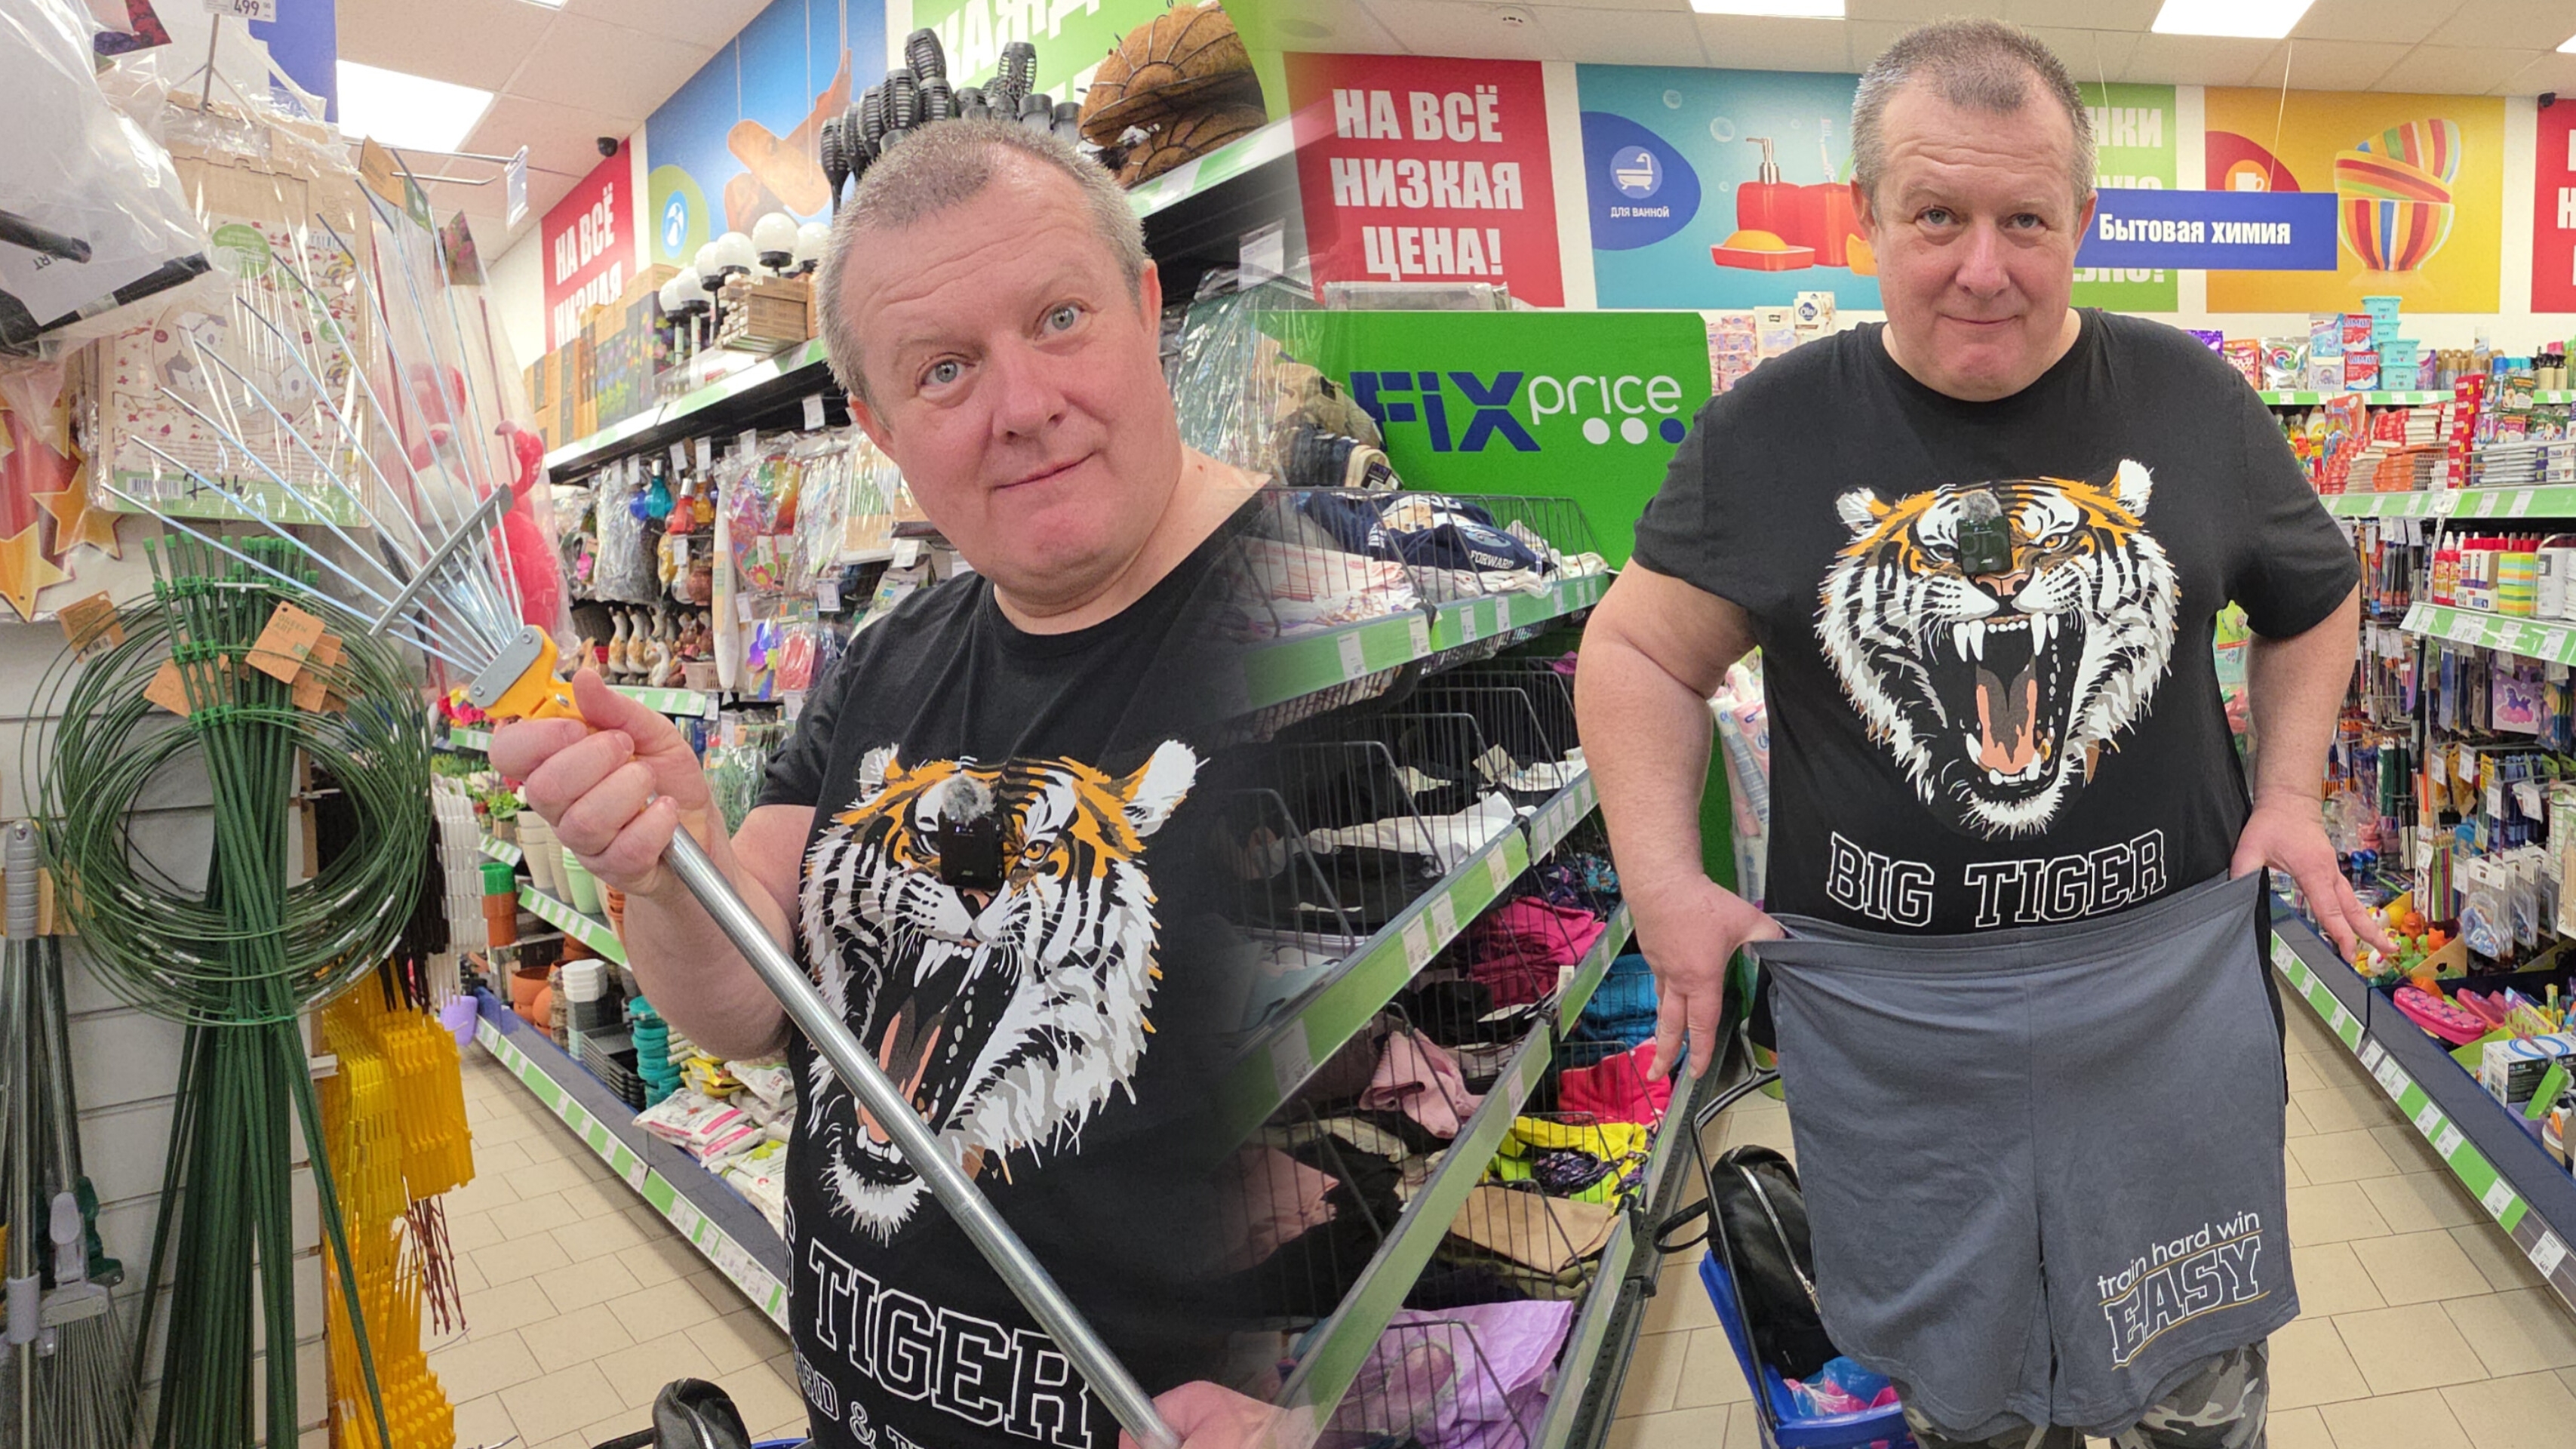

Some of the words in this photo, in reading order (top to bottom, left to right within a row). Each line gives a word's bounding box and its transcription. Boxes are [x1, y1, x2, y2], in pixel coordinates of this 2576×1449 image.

[1333, 89, 1402, 140] НА
[1409, 85, 1502, 142] ВСЁ
[1329, 158, 1523, 210] НИЗКАЯ
[1610, 206, 1631, 218] ДЛЯ
[1632, 205, 1670, 218] ВАННОЙ
[554, 225, 579, 286] НА
[579, 182, 615, 267] ВСЁ
[1362, 226, 1503, 281] ЦЕНА!
[2098, 213, 2205, 244] Бытовая
[2212, 221, 2291, 245] химия
[1528, 375, 1683, 425] price
[1471, 549, 1514, 569] FORWARD
[1826, 831, 1935, 928] BIG
[1964, 829, 2167, 928] TIGER
[2097, 1256, 2147, 1299] train
[2151, 1223, 2211, 1266] hard
[2216, 1211, 2261, 1240] win
[2104, 1235, 2261, 1364] EASY
[808, 1236, 1092, 1449] TIGER
